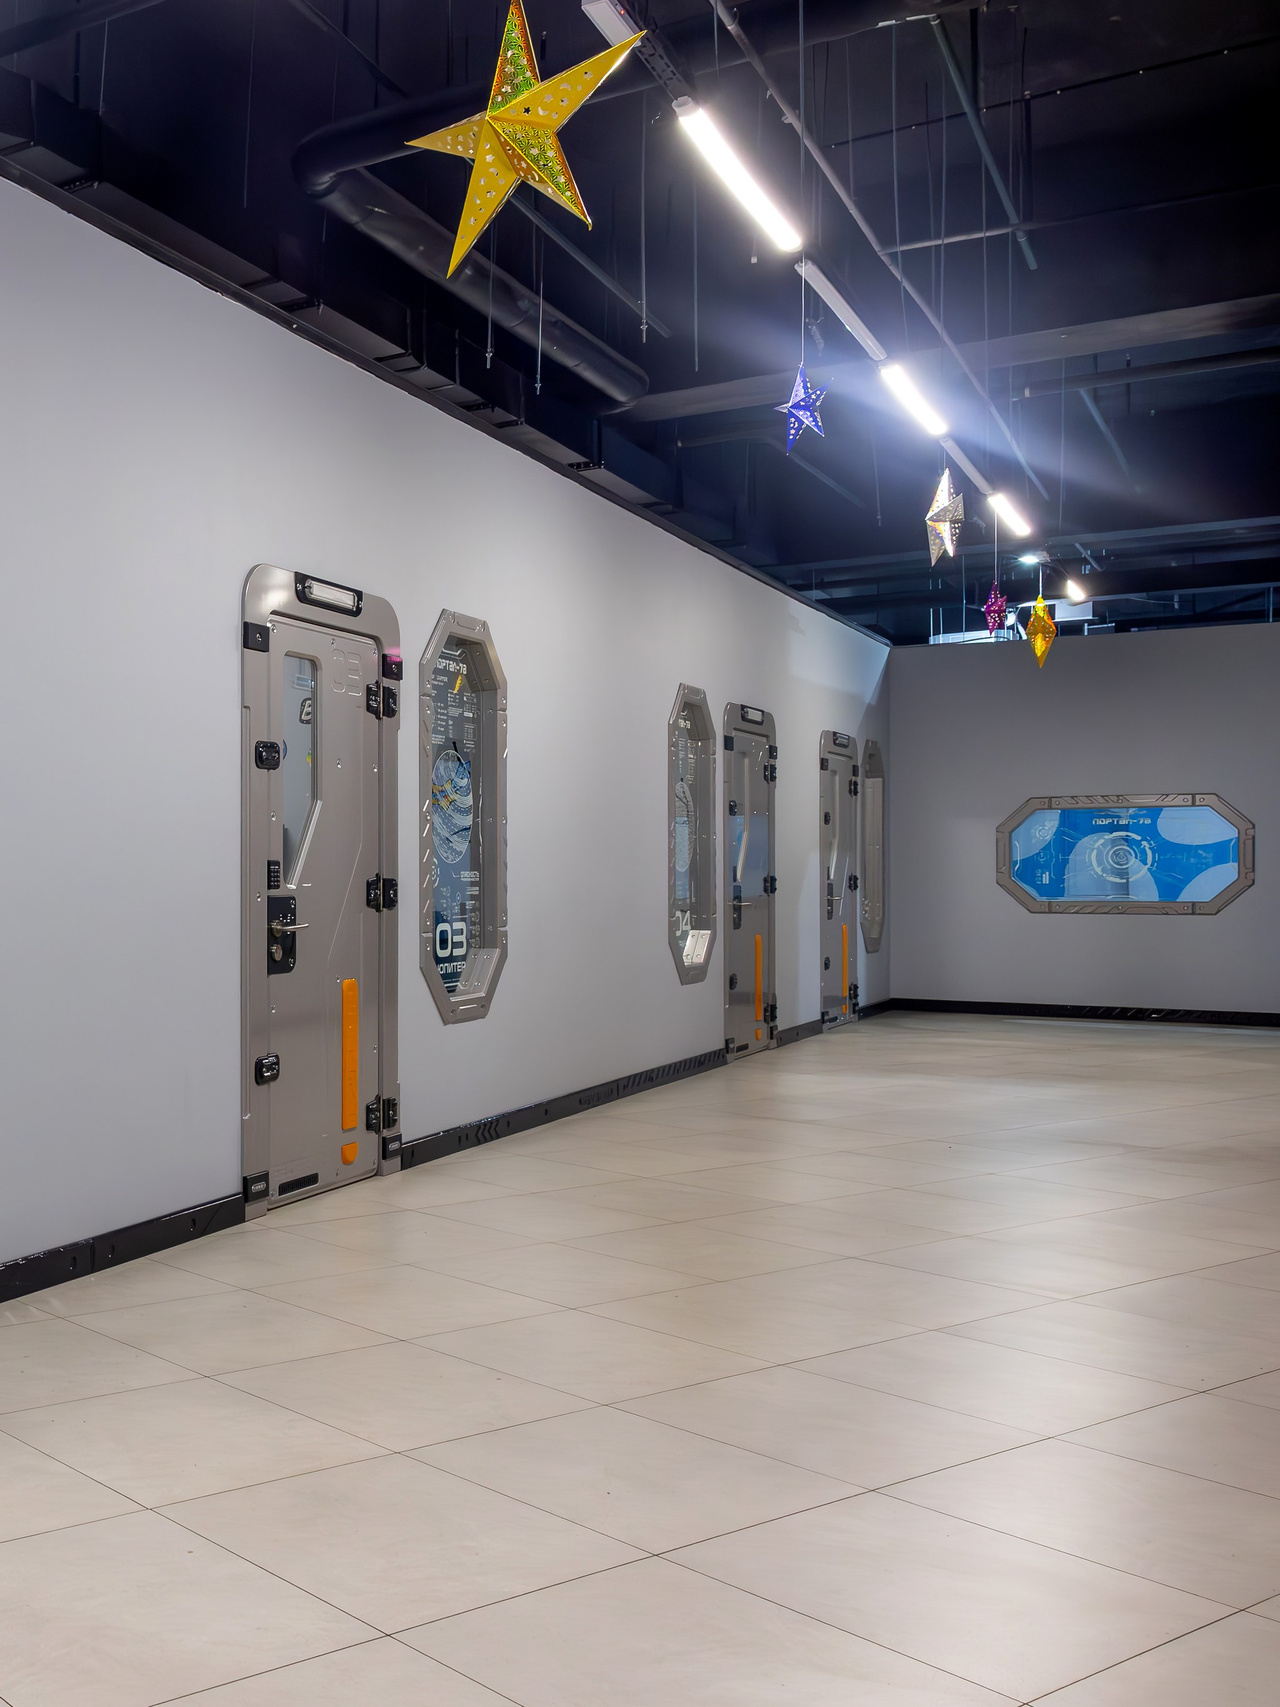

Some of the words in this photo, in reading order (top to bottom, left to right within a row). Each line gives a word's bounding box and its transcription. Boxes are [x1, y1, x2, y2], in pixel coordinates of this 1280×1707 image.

[330, 647, 363, 697] 03
[1092, 817, 1152, 826] ПОРТАЛ-78
[435, 921, 467, 958] 03
